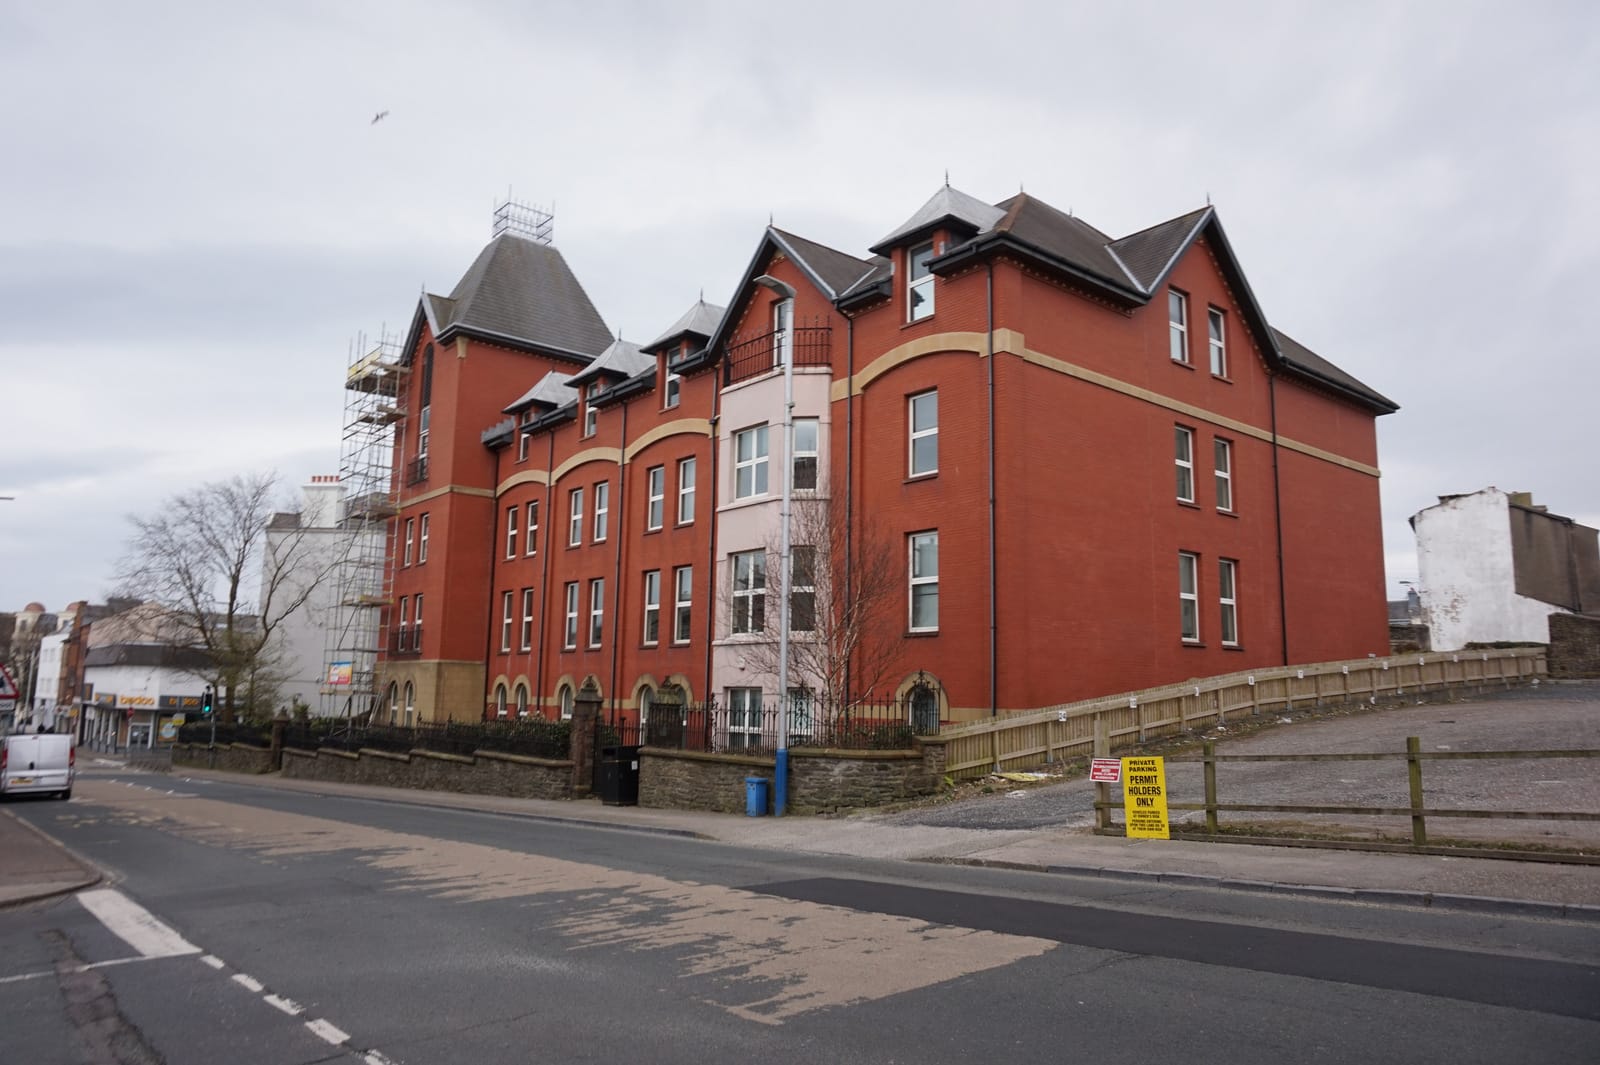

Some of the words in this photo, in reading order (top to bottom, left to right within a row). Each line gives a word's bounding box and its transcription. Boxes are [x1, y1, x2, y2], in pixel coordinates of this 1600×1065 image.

[1130, 775, 1158, 784] PERMIT
[1128, 786, 1161, 795] HOLDERS
[1136, 797, 1154, 806] ONLY
